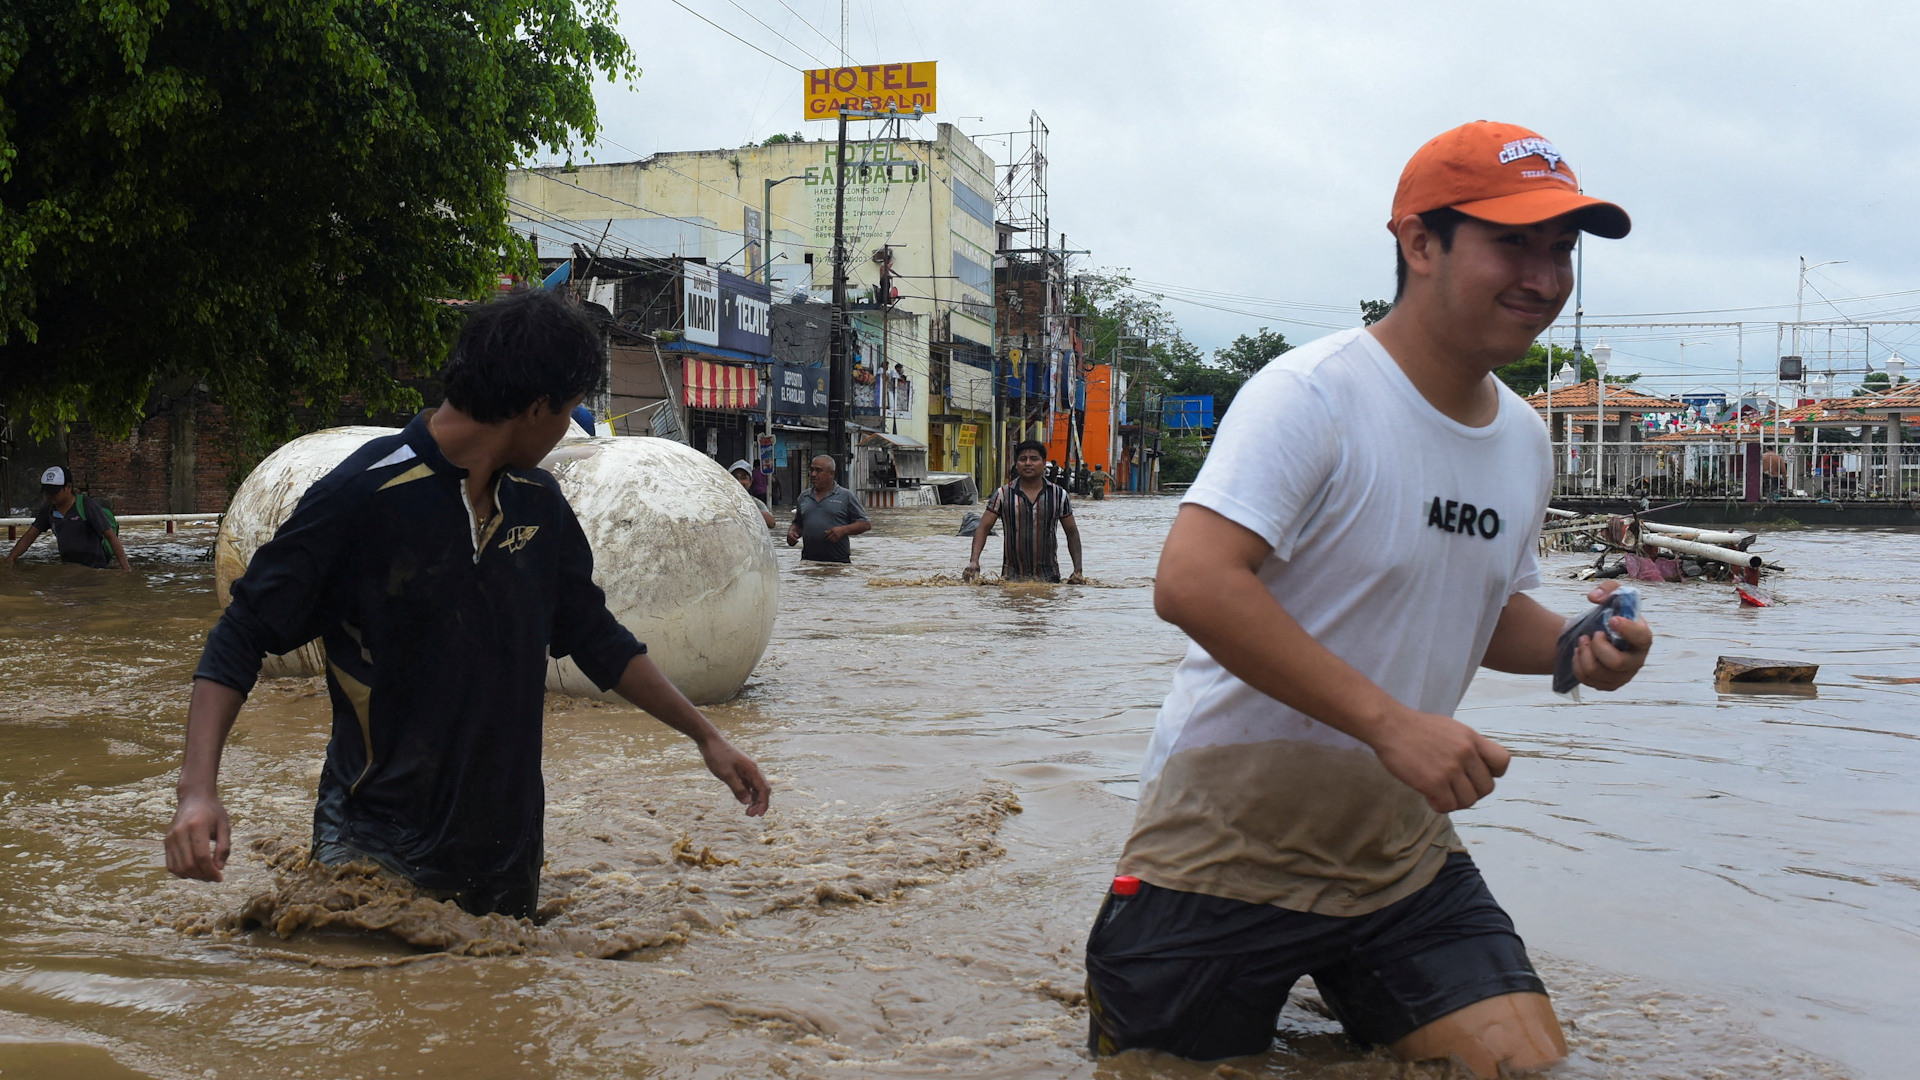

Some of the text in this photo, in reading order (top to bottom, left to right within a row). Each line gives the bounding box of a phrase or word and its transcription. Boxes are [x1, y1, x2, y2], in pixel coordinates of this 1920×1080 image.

[811, 64, 928, 95] HOTEL
[810, 93, 931, 114] GARIBALDI
[825, 143, 904, 164] HOTEL
[688, 292, 716, 332] MARY
[735, 294, 770, 337] TECATE
[1428, 496, 1500, 540] AERO
